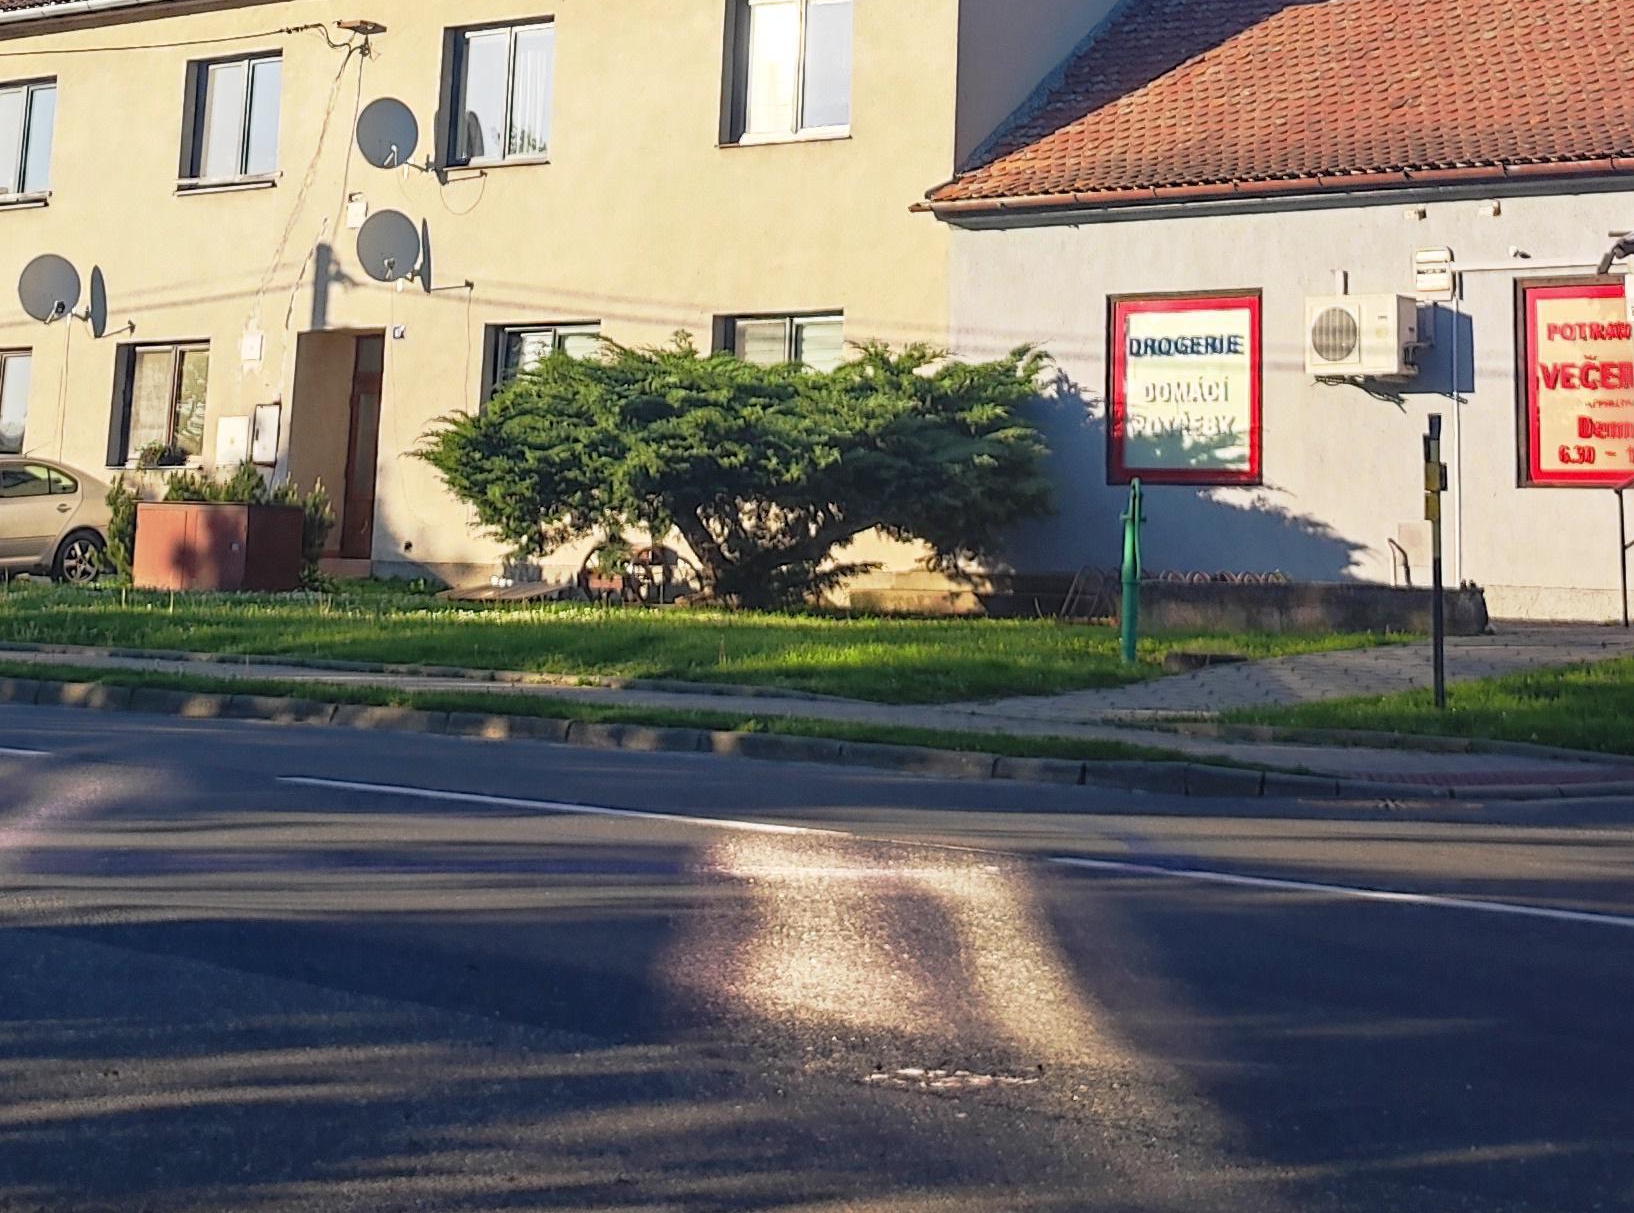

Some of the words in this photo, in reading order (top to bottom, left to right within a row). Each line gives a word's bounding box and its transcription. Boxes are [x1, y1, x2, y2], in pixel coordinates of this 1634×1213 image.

[1129, 334, 1245, 357] DROGERIE
[1144, 375, 1229, 403] DOMÁCÍ
[1558, 444, 1596, 464] 6.30
